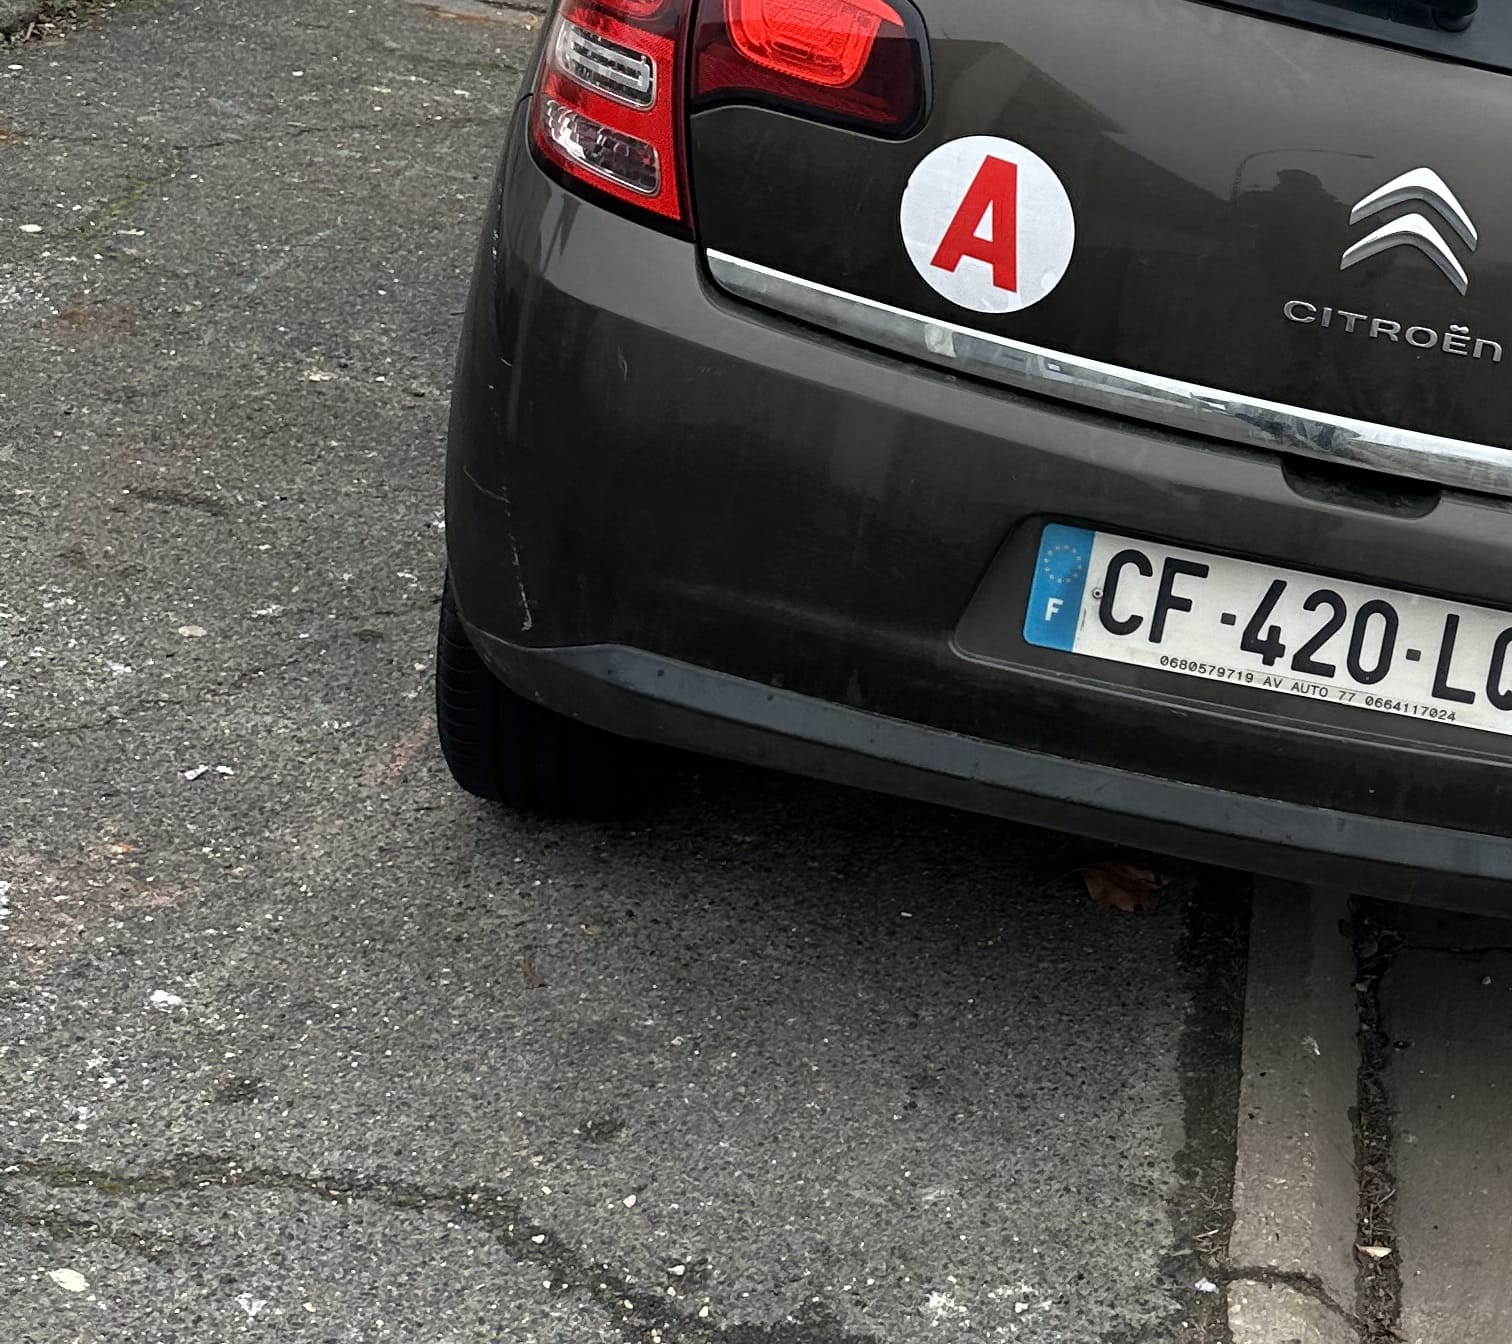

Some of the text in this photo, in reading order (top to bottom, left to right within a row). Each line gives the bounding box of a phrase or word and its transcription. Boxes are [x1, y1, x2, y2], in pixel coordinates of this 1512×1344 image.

[930, 154, 1018, 293] A
[1044, 597, 1064, 622] F
[1160, 655, 1456, 722] 0680579719 AV AUTO 77 0664117024
